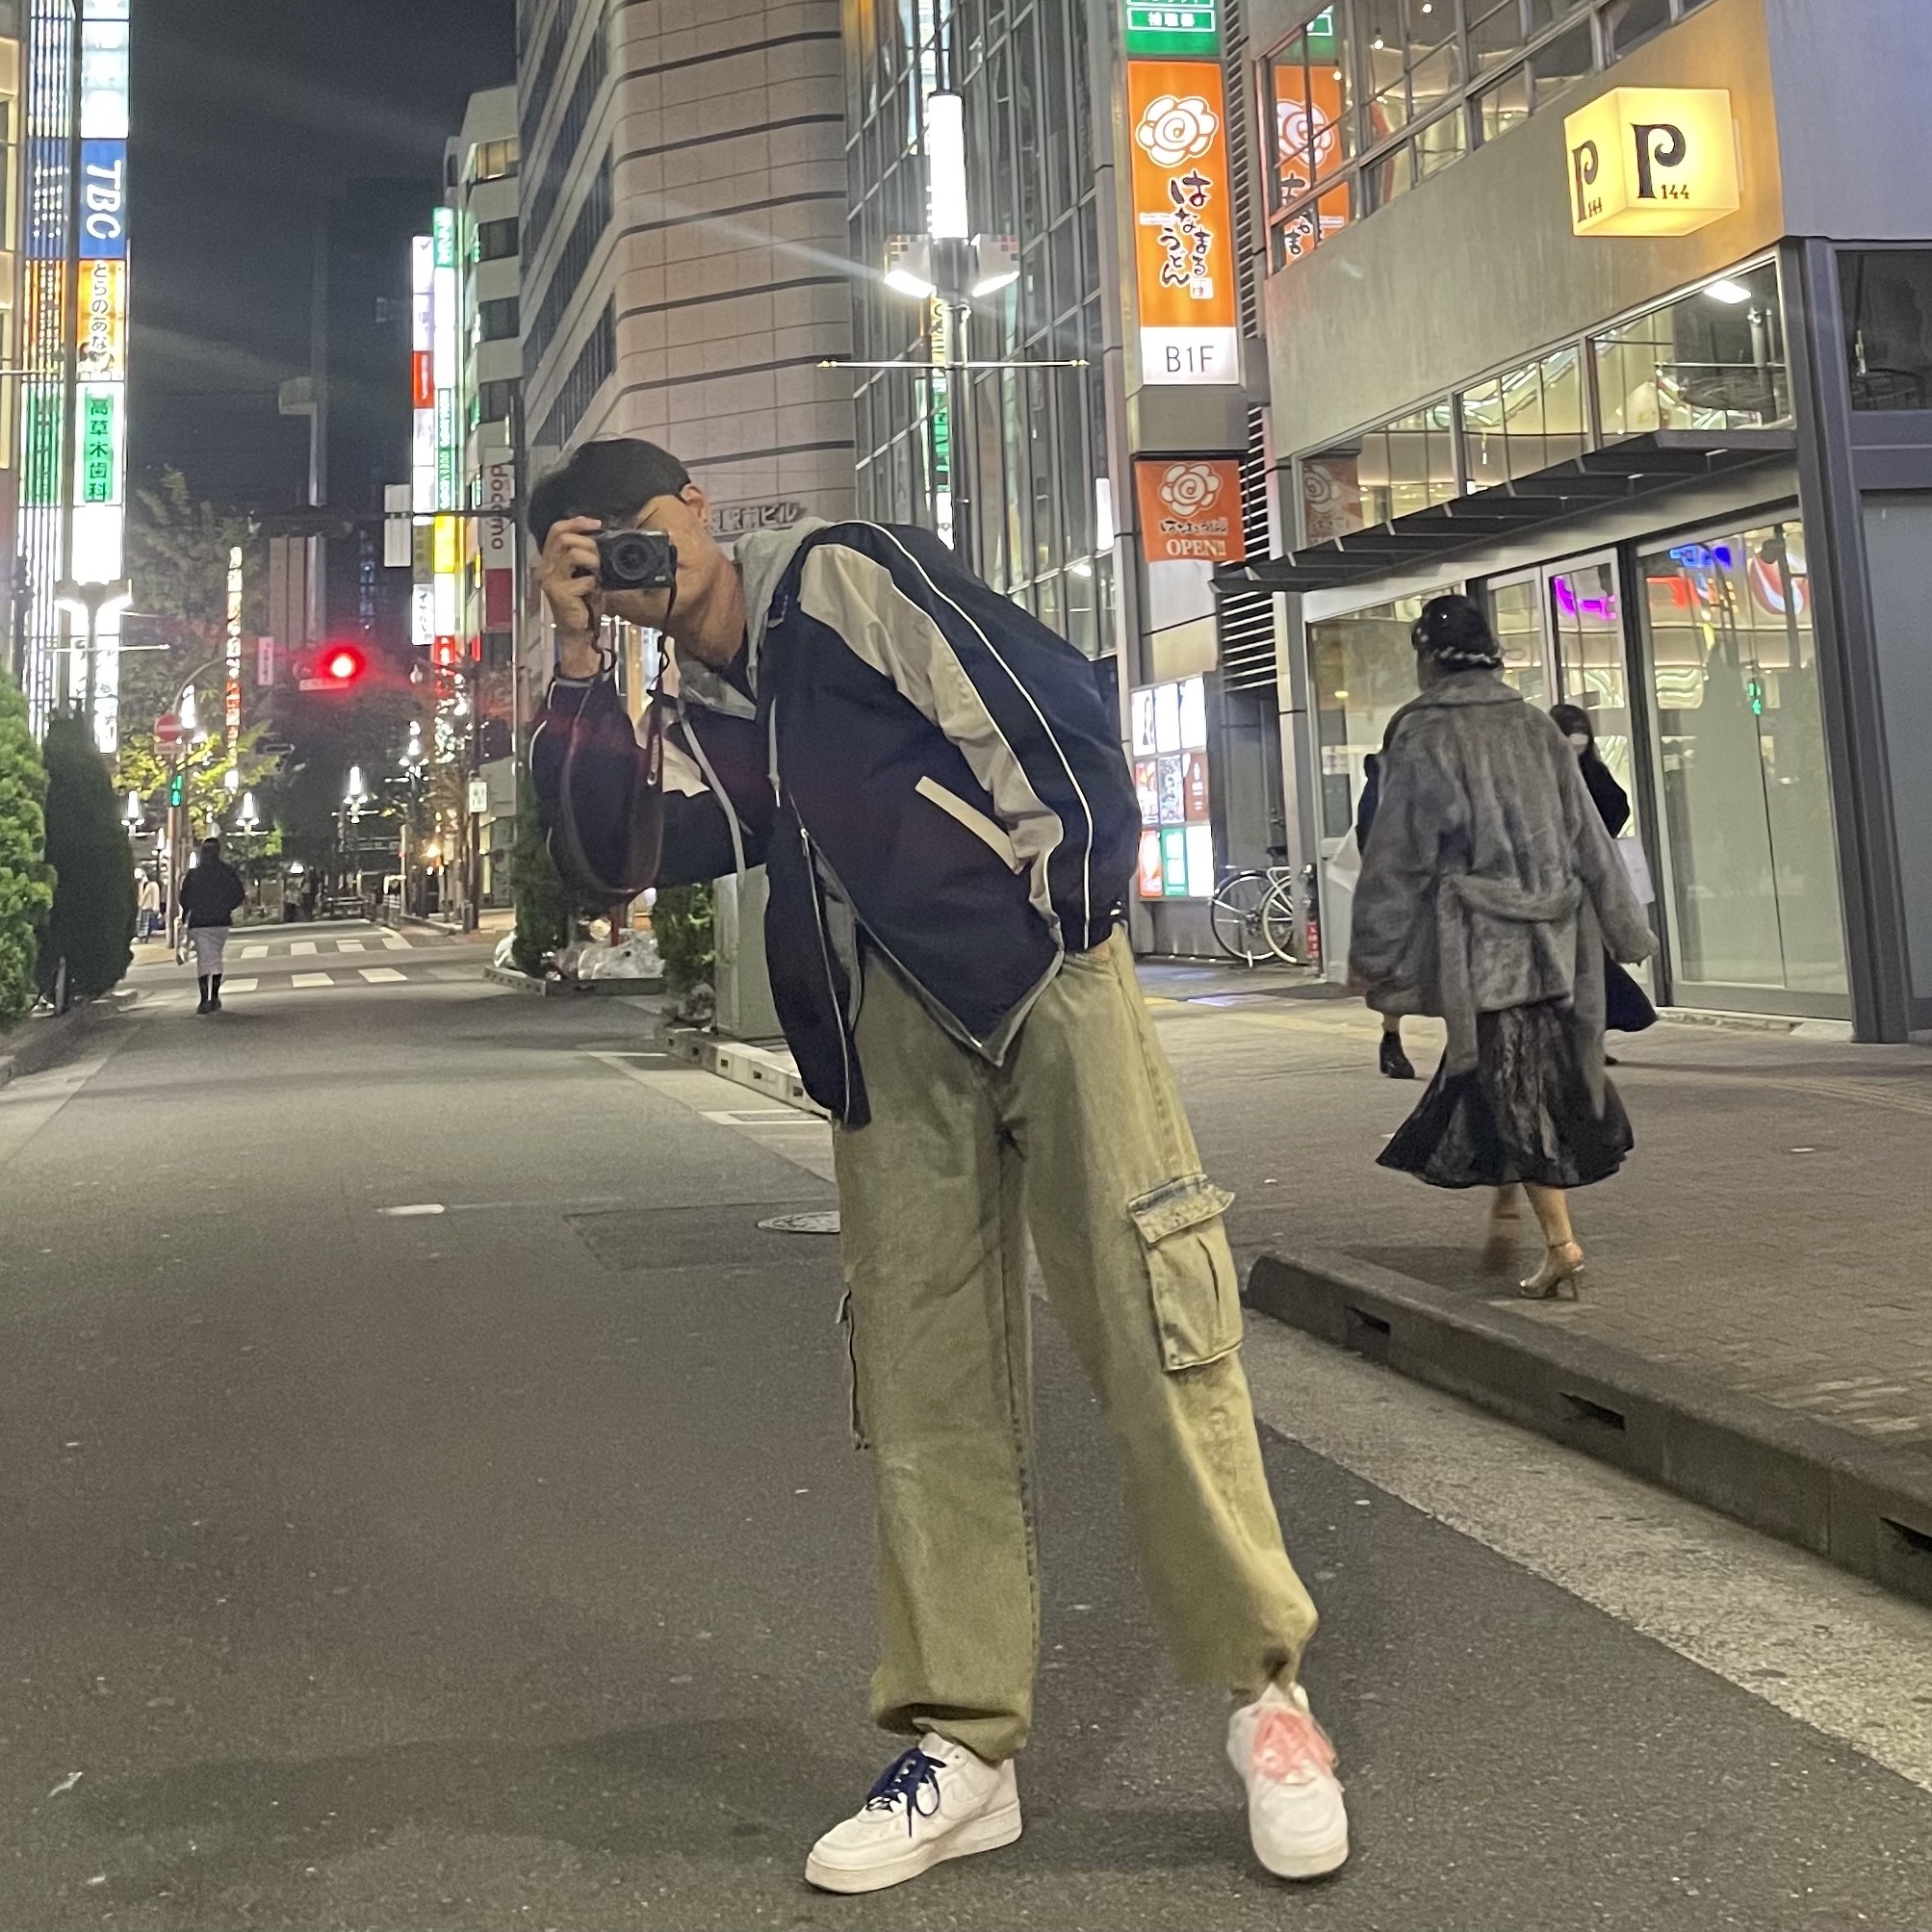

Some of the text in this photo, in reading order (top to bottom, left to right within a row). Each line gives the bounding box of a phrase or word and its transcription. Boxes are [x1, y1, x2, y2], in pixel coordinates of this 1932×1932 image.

[86, 159, 122, 241] TBC
[1572, 139, 1599, 223] P
[1629, 122, 1689, 200] P 144
[1158, 227, 1191, 286] うどん
[1170, 169, 1212, 276] はなまる
[90, 263, 110, 351] とらのあな
[1165, 345, 1215, 374] B1F
[88, 398, 110, 500] 高草木歯科
